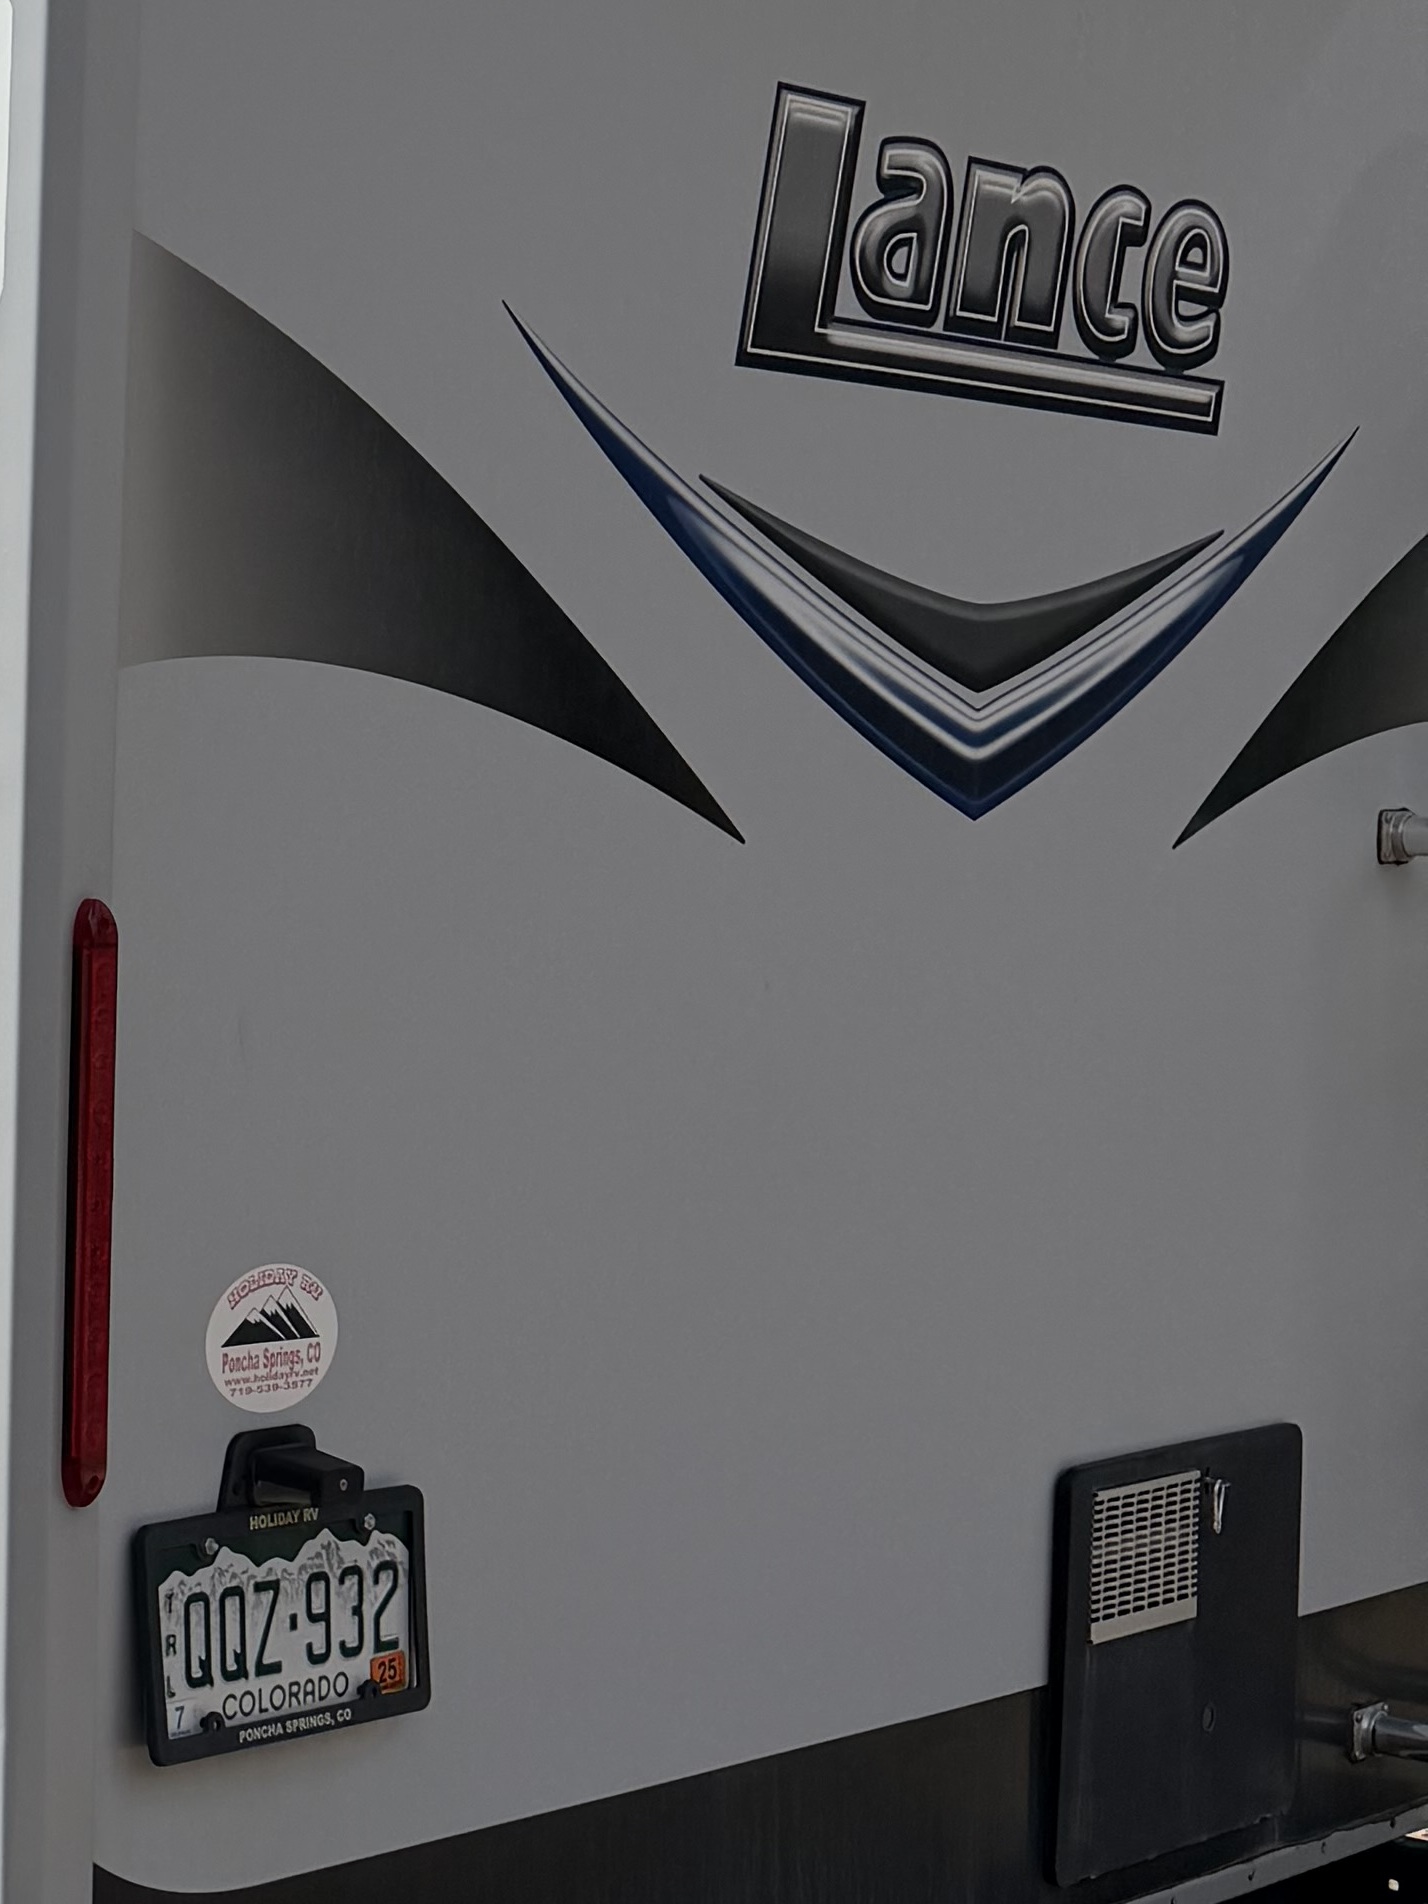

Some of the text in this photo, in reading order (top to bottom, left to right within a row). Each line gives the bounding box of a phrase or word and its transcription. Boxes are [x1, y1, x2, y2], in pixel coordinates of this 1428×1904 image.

[734, 80, 1230, 437] Lance
[227, 1268, 323, 1310] HOLIDAY RV
[222, 1342, 321, 1374] Poncha Springs, CO
[224, 1367, 319, 1386] www.holidayrv.net
[249, 1507, 319, 1530] HOLIDAY RV
[378, 1657, 398, 1683] 25
[222, 1671, 349, 1721] COLORADO
[174, 1706, 185, 1730] 7
[239, 1708, 352, 1744] PONCHA SPRINGS, CO
